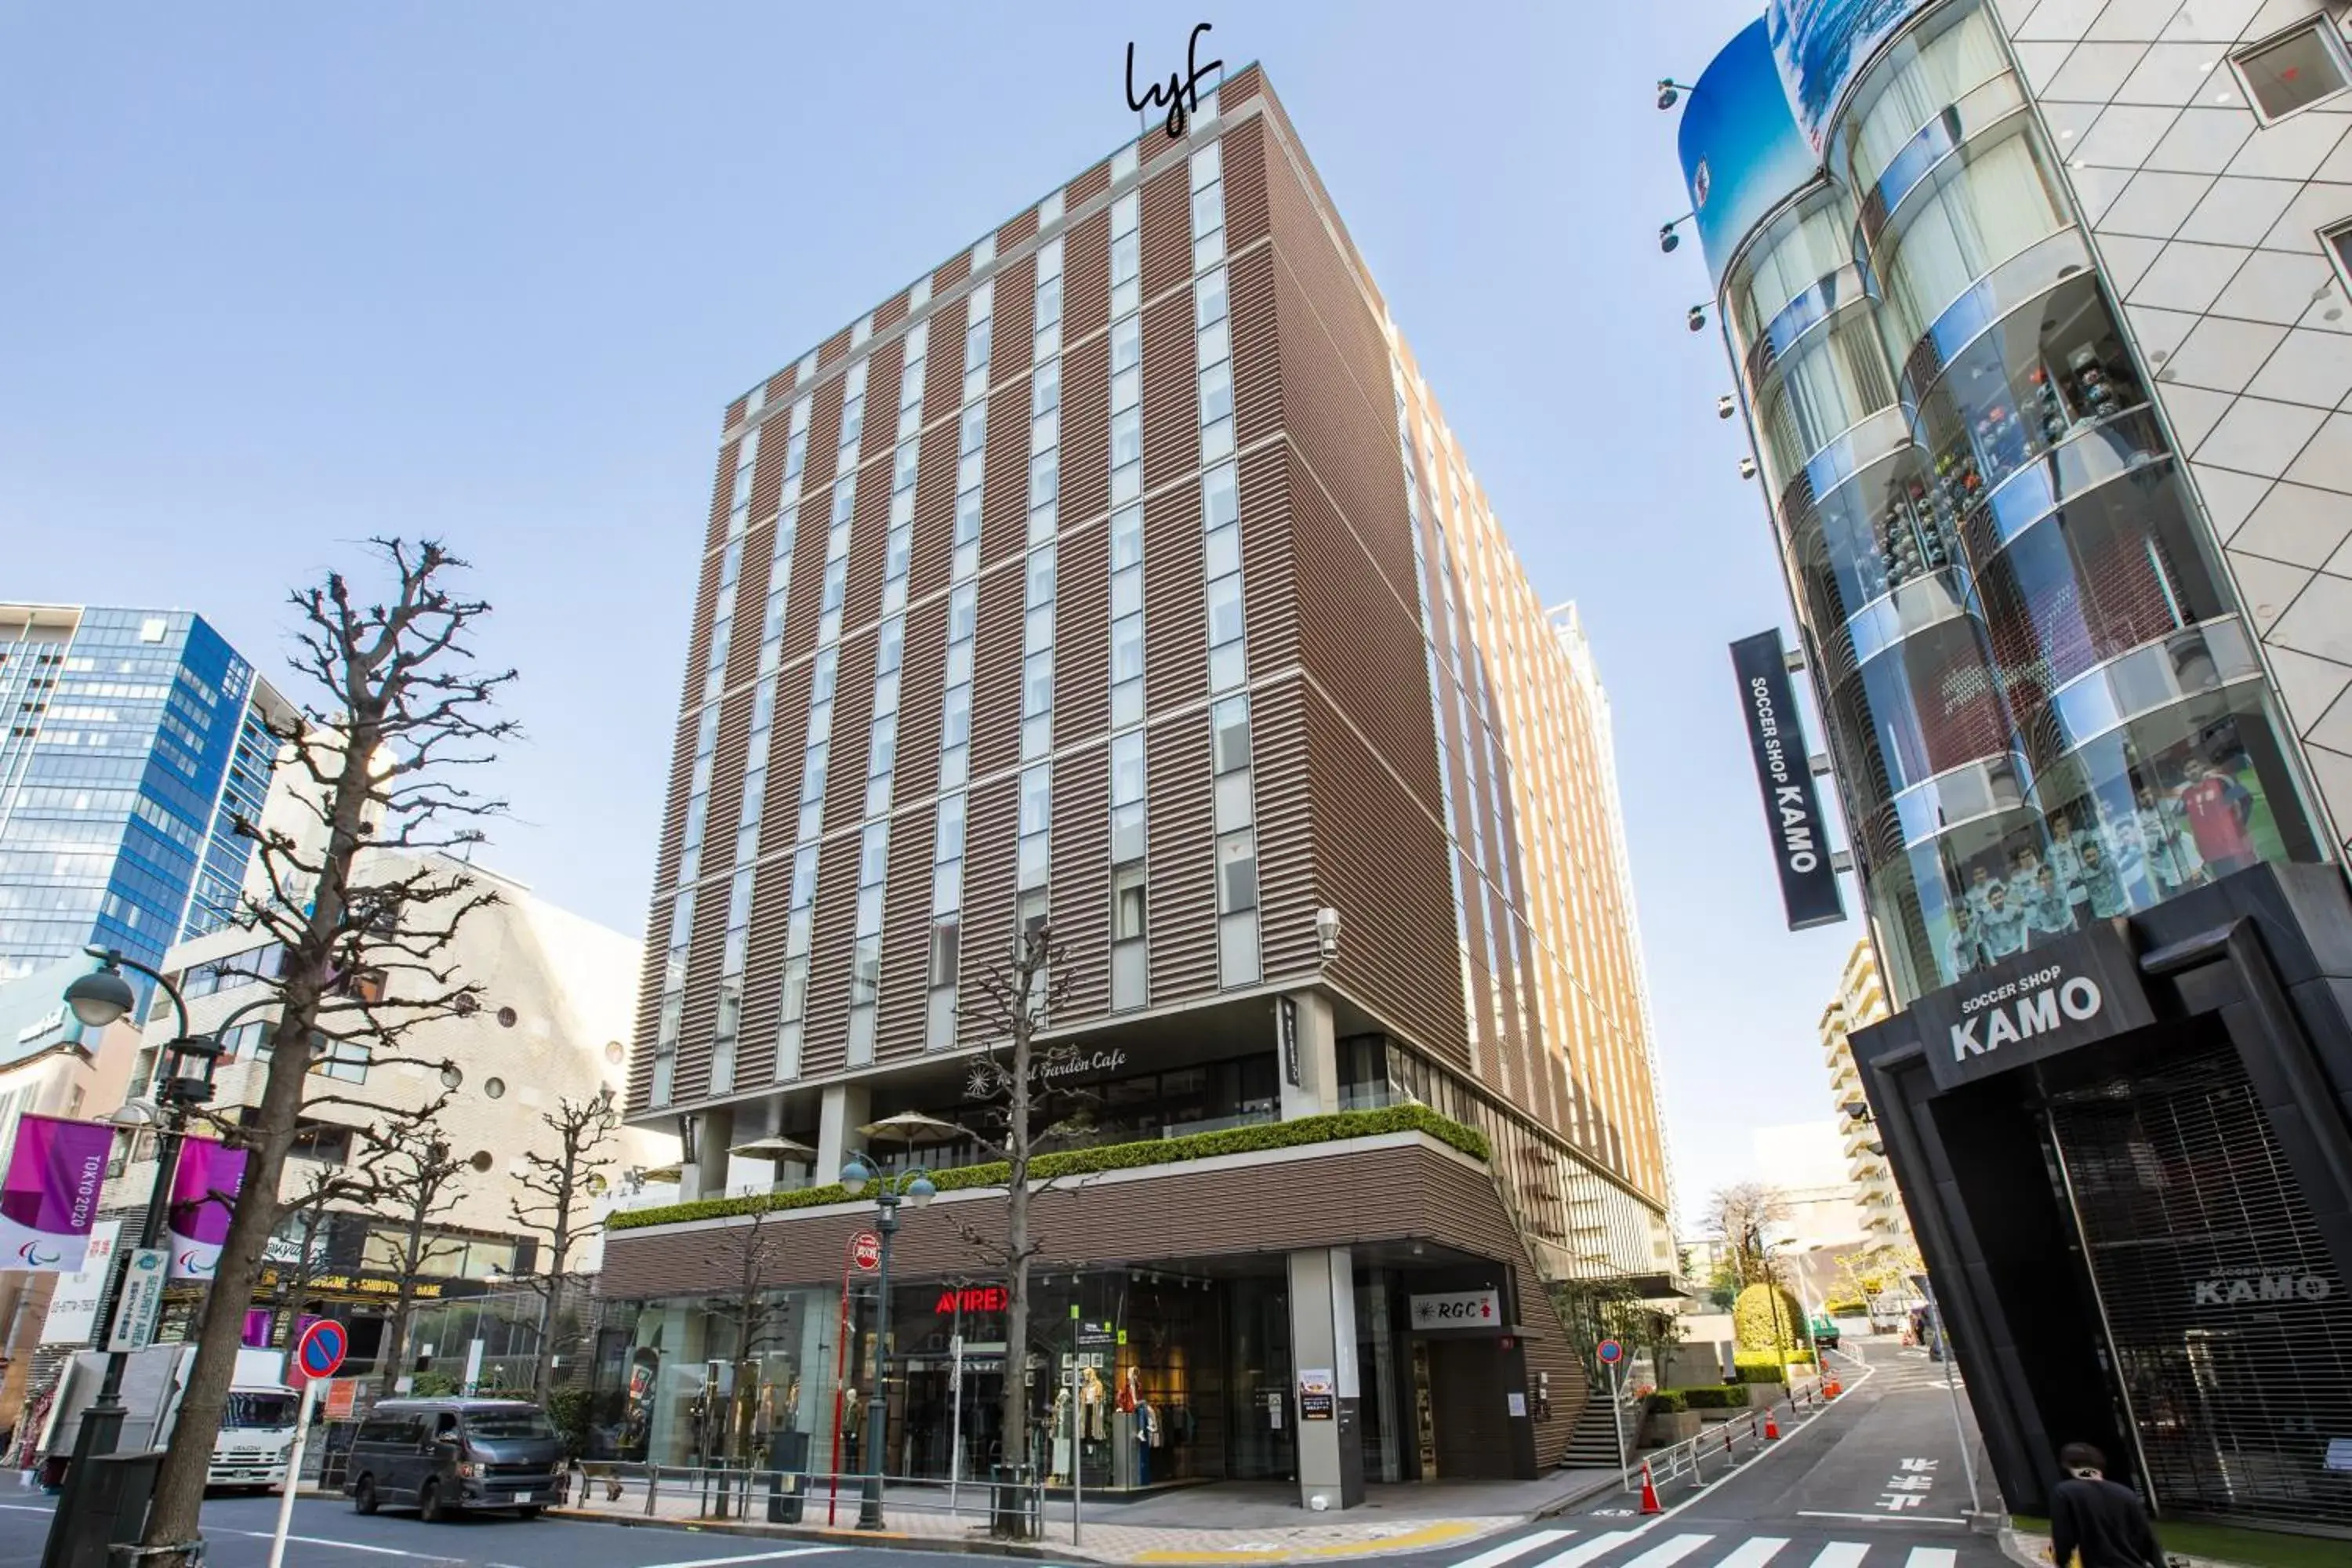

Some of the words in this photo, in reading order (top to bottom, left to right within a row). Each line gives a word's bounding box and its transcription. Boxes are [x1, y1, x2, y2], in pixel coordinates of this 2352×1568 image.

[1126, 22, 1223, 138] lyf
[1751, 677, 1777, 738] SOCCER
[1765, 739, 1788, 783] SHOP
[1775, 786, 1817, 873] KAMO
[1962, 982, 2017, 1014] SOCCER
[2019, 965, 2061, 991] SHOP
[1950, 976, 2101, 1062] KAMO
[78, 1155, 101, 1195] TOKYO
[71, 1197, 90, 1227] 2020
[1438, 1301, 1476, 1319] RGC
[2194, 1275, 2331, 1305] KAMO
